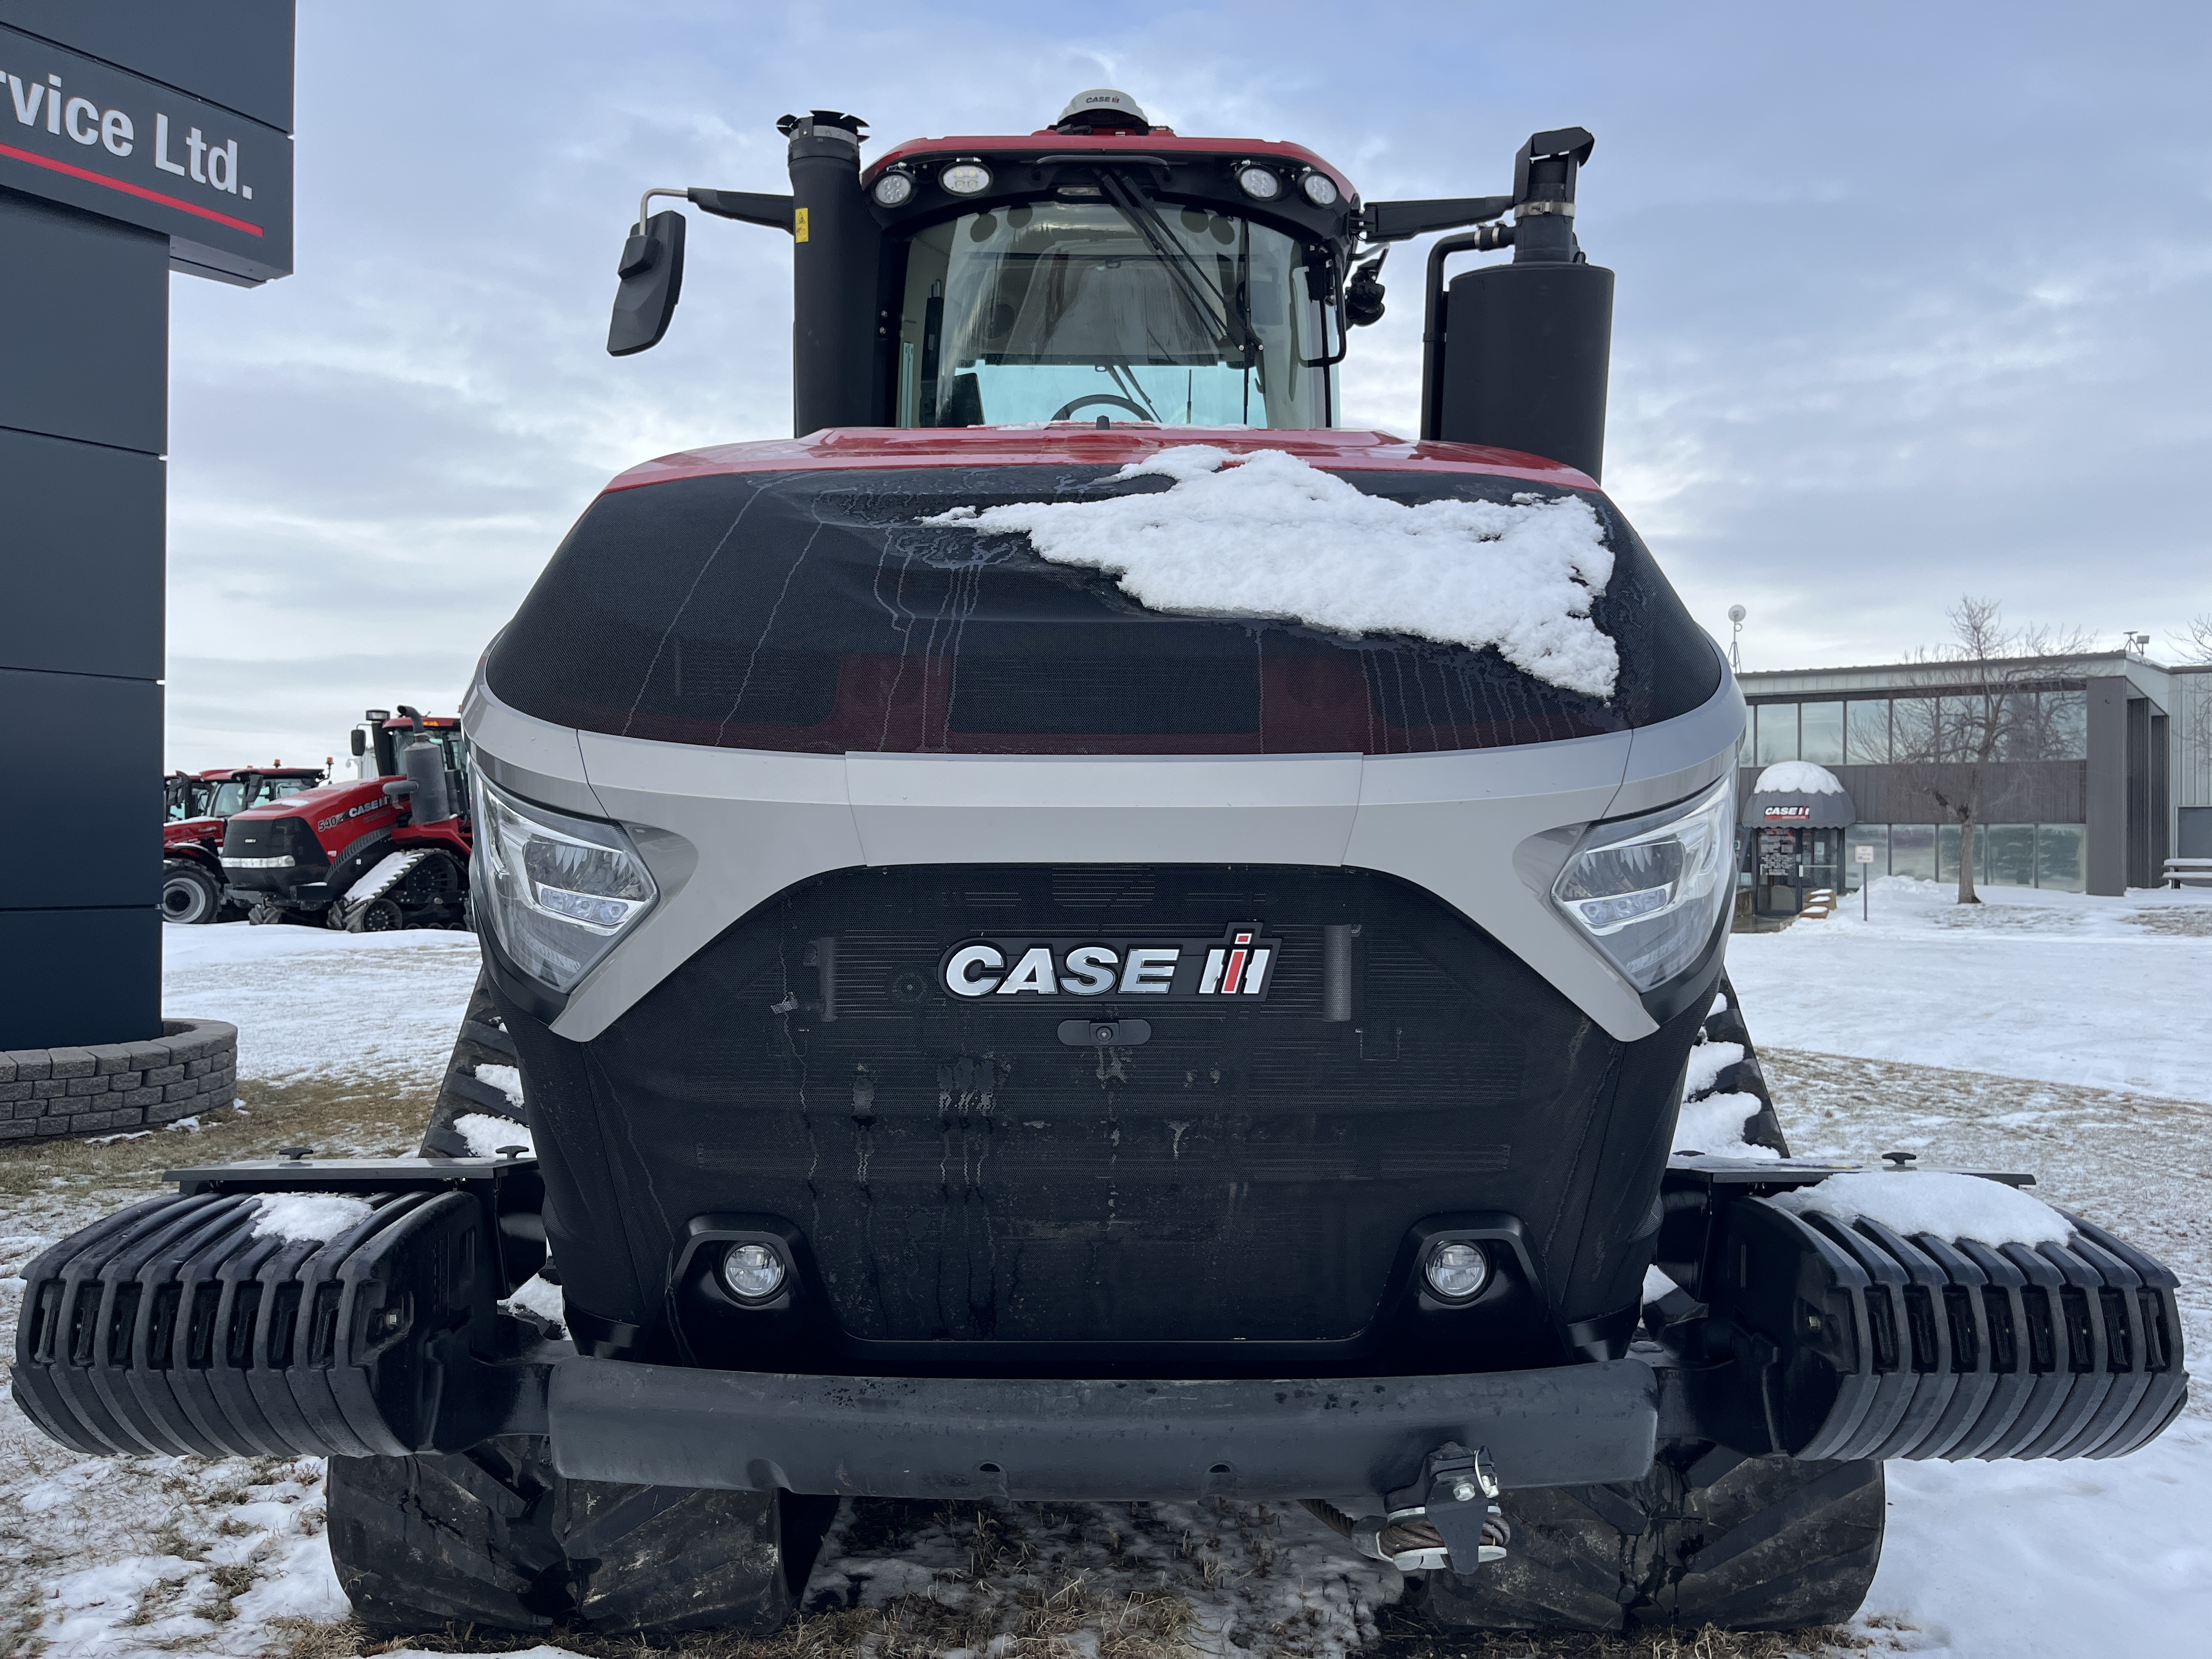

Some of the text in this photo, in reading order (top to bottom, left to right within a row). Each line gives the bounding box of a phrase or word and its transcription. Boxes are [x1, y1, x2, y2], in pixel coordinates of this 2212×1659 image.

[155, 112, 253, 200] Ltd.
[349, 799, 379, 817] CASE
[1765, 806, 1798, 816] CASE
[318, 816, 337, 832] 540
[946, 946, 1180, 996] CASE
